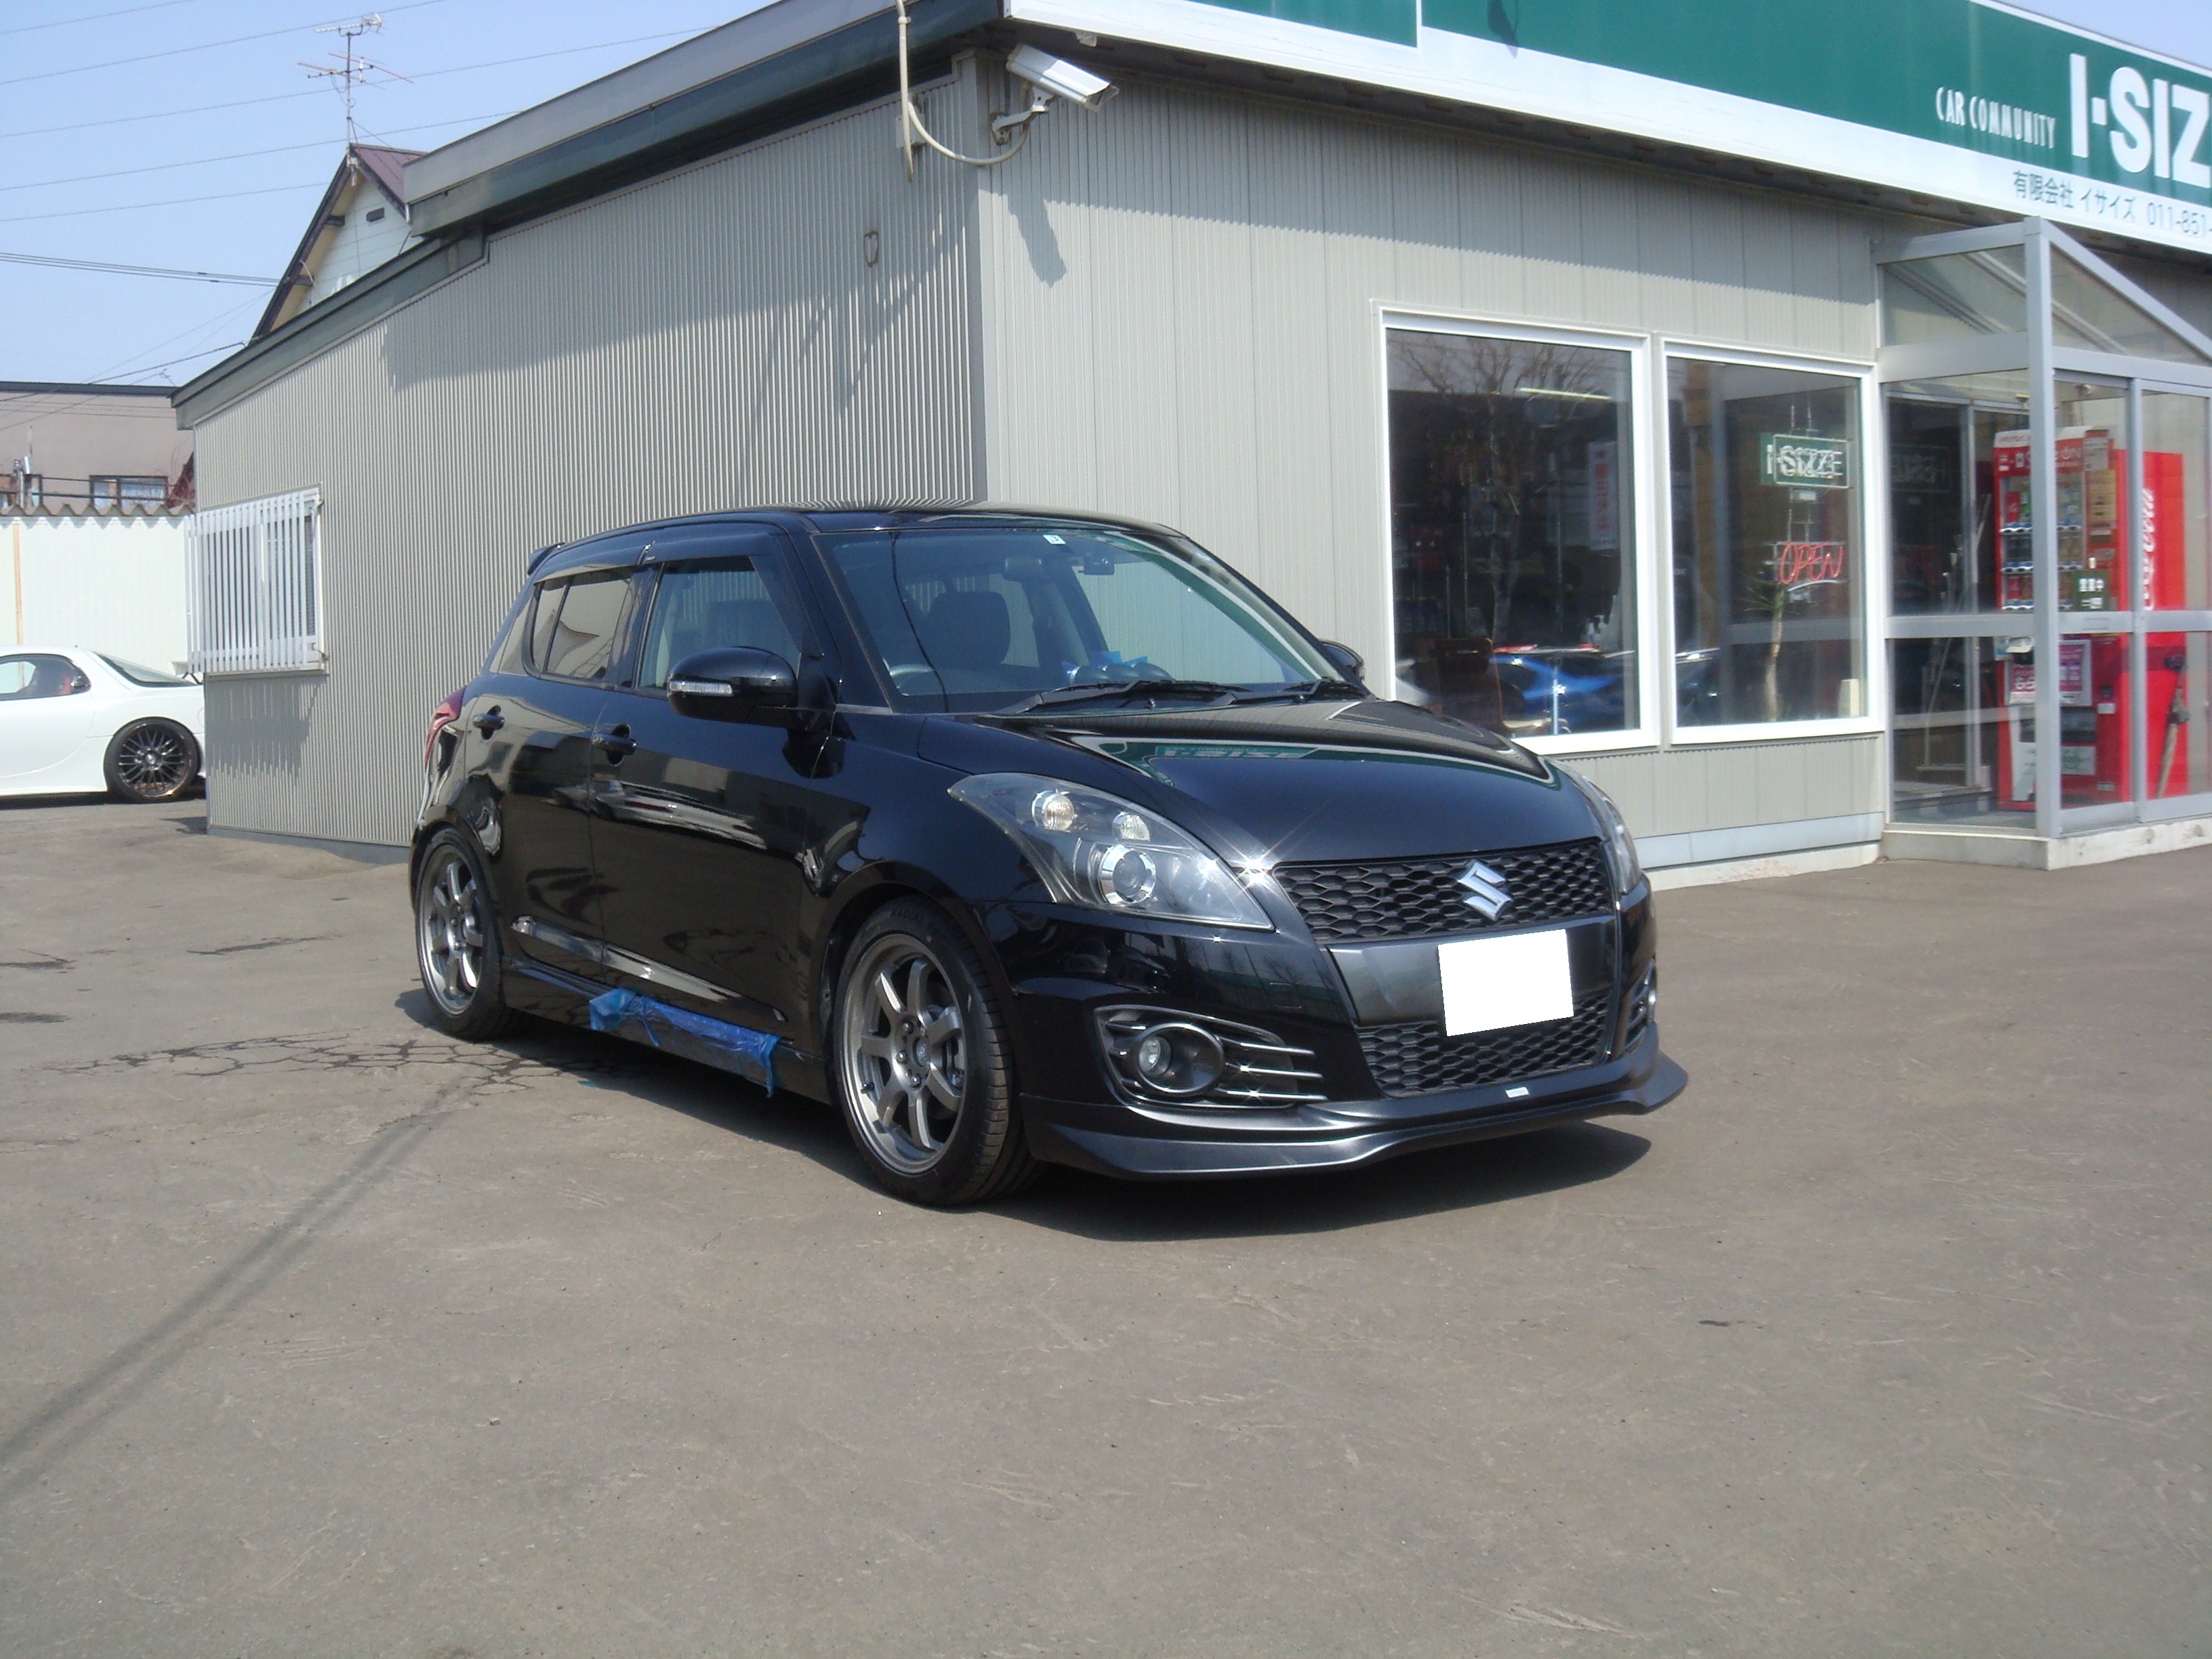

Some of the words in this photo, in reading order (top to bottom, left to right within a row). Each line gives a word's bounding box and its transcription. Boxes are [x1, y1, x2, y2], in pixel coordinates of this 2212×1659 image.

[1935, 86, 1965, 126] CAR
[1969, 96, 2056, 149] COMMUNITY
[2013, 169, 2074, 209] 有限会社
[2080, 188, 2138, 223] イサイズ
[1778, 542, 1843, 586] OPEN
